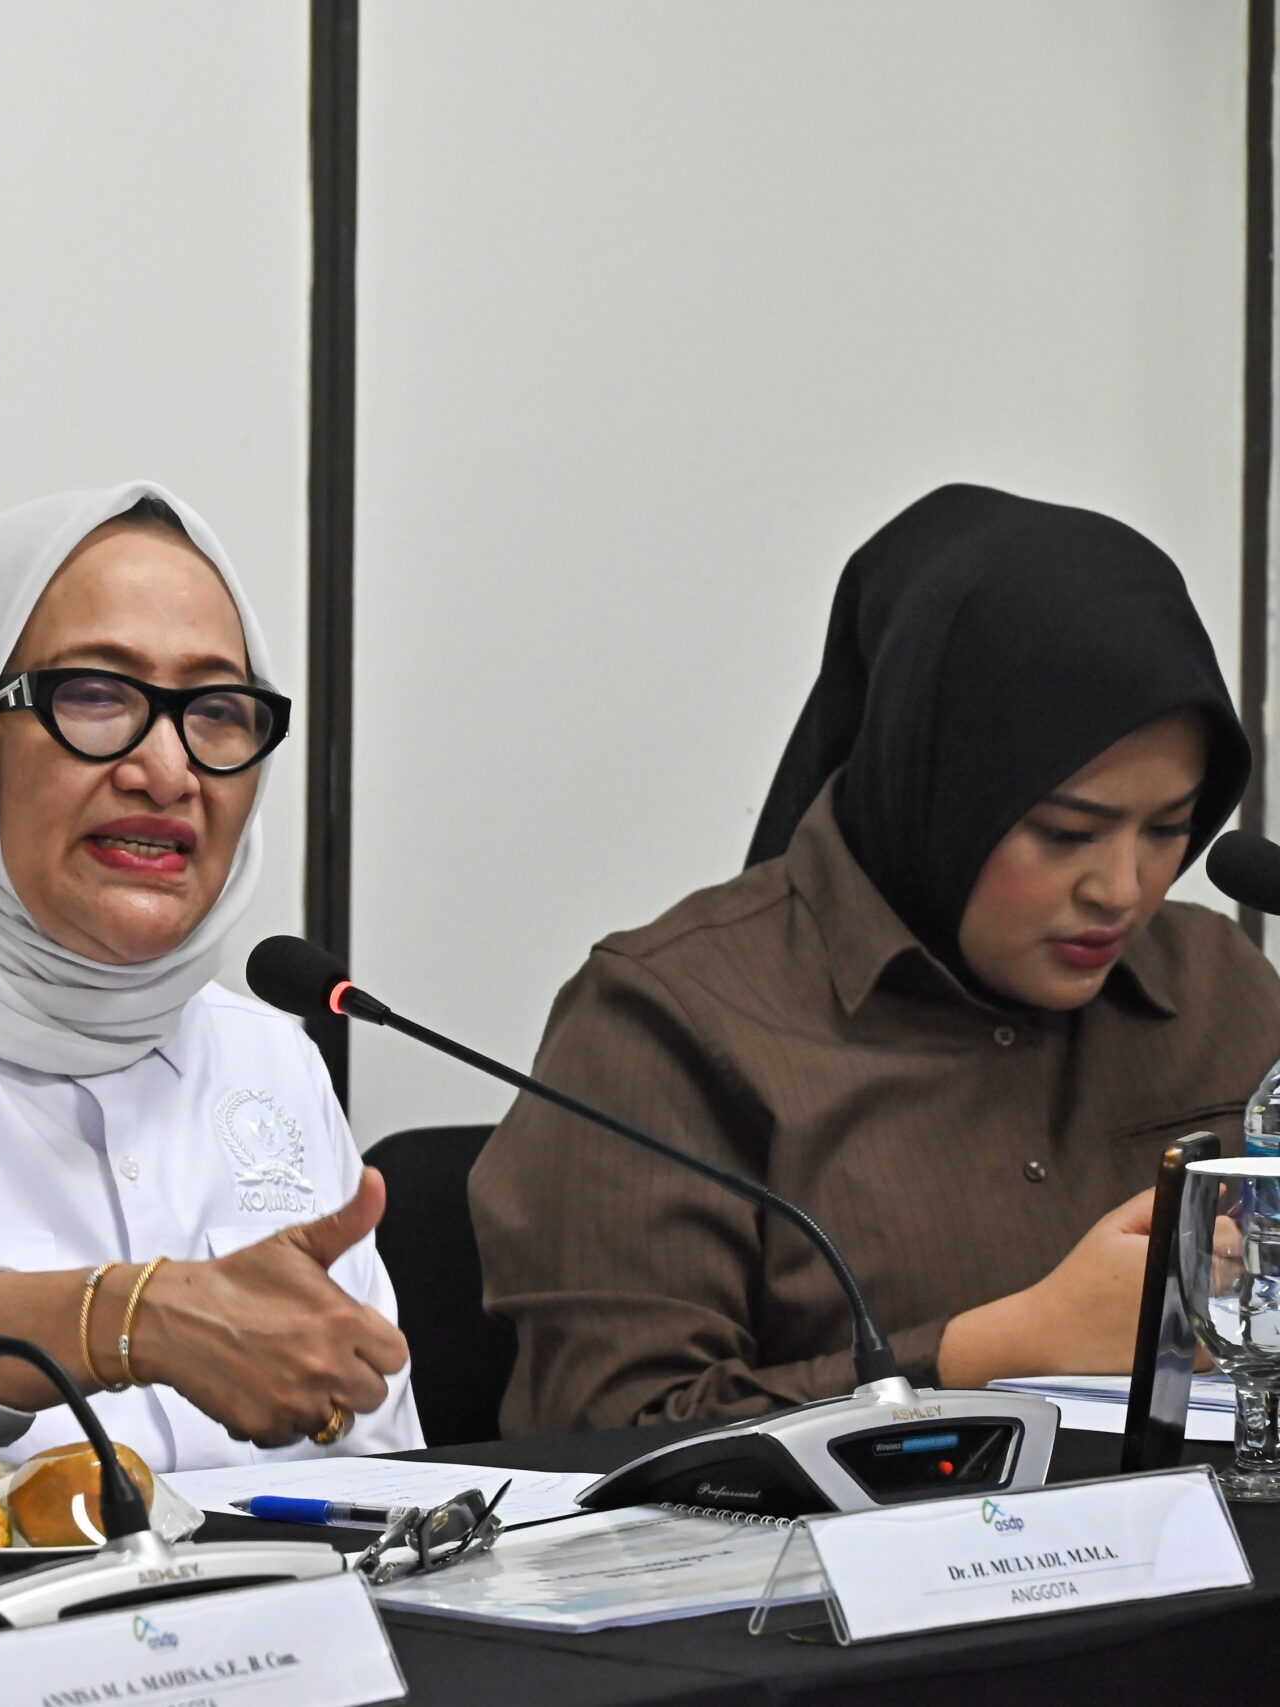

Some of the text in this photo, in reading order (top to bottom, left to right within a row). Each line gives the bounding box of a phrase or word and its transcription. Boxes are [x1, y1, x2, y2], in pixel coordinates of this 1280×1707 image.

[891, 1405, 943, 1421] ASHLEY
[697, 1482, 761, 1499] Professional
[994, 1515, 1024, 1532] asdp
[947, 1545, 1119, 1581] Dr. H. MULYADI, M.M.A.
[139, 1562, 199, 1584] ASHLEY
[1010, 1581, 1079, 1604] ANGGOTA
